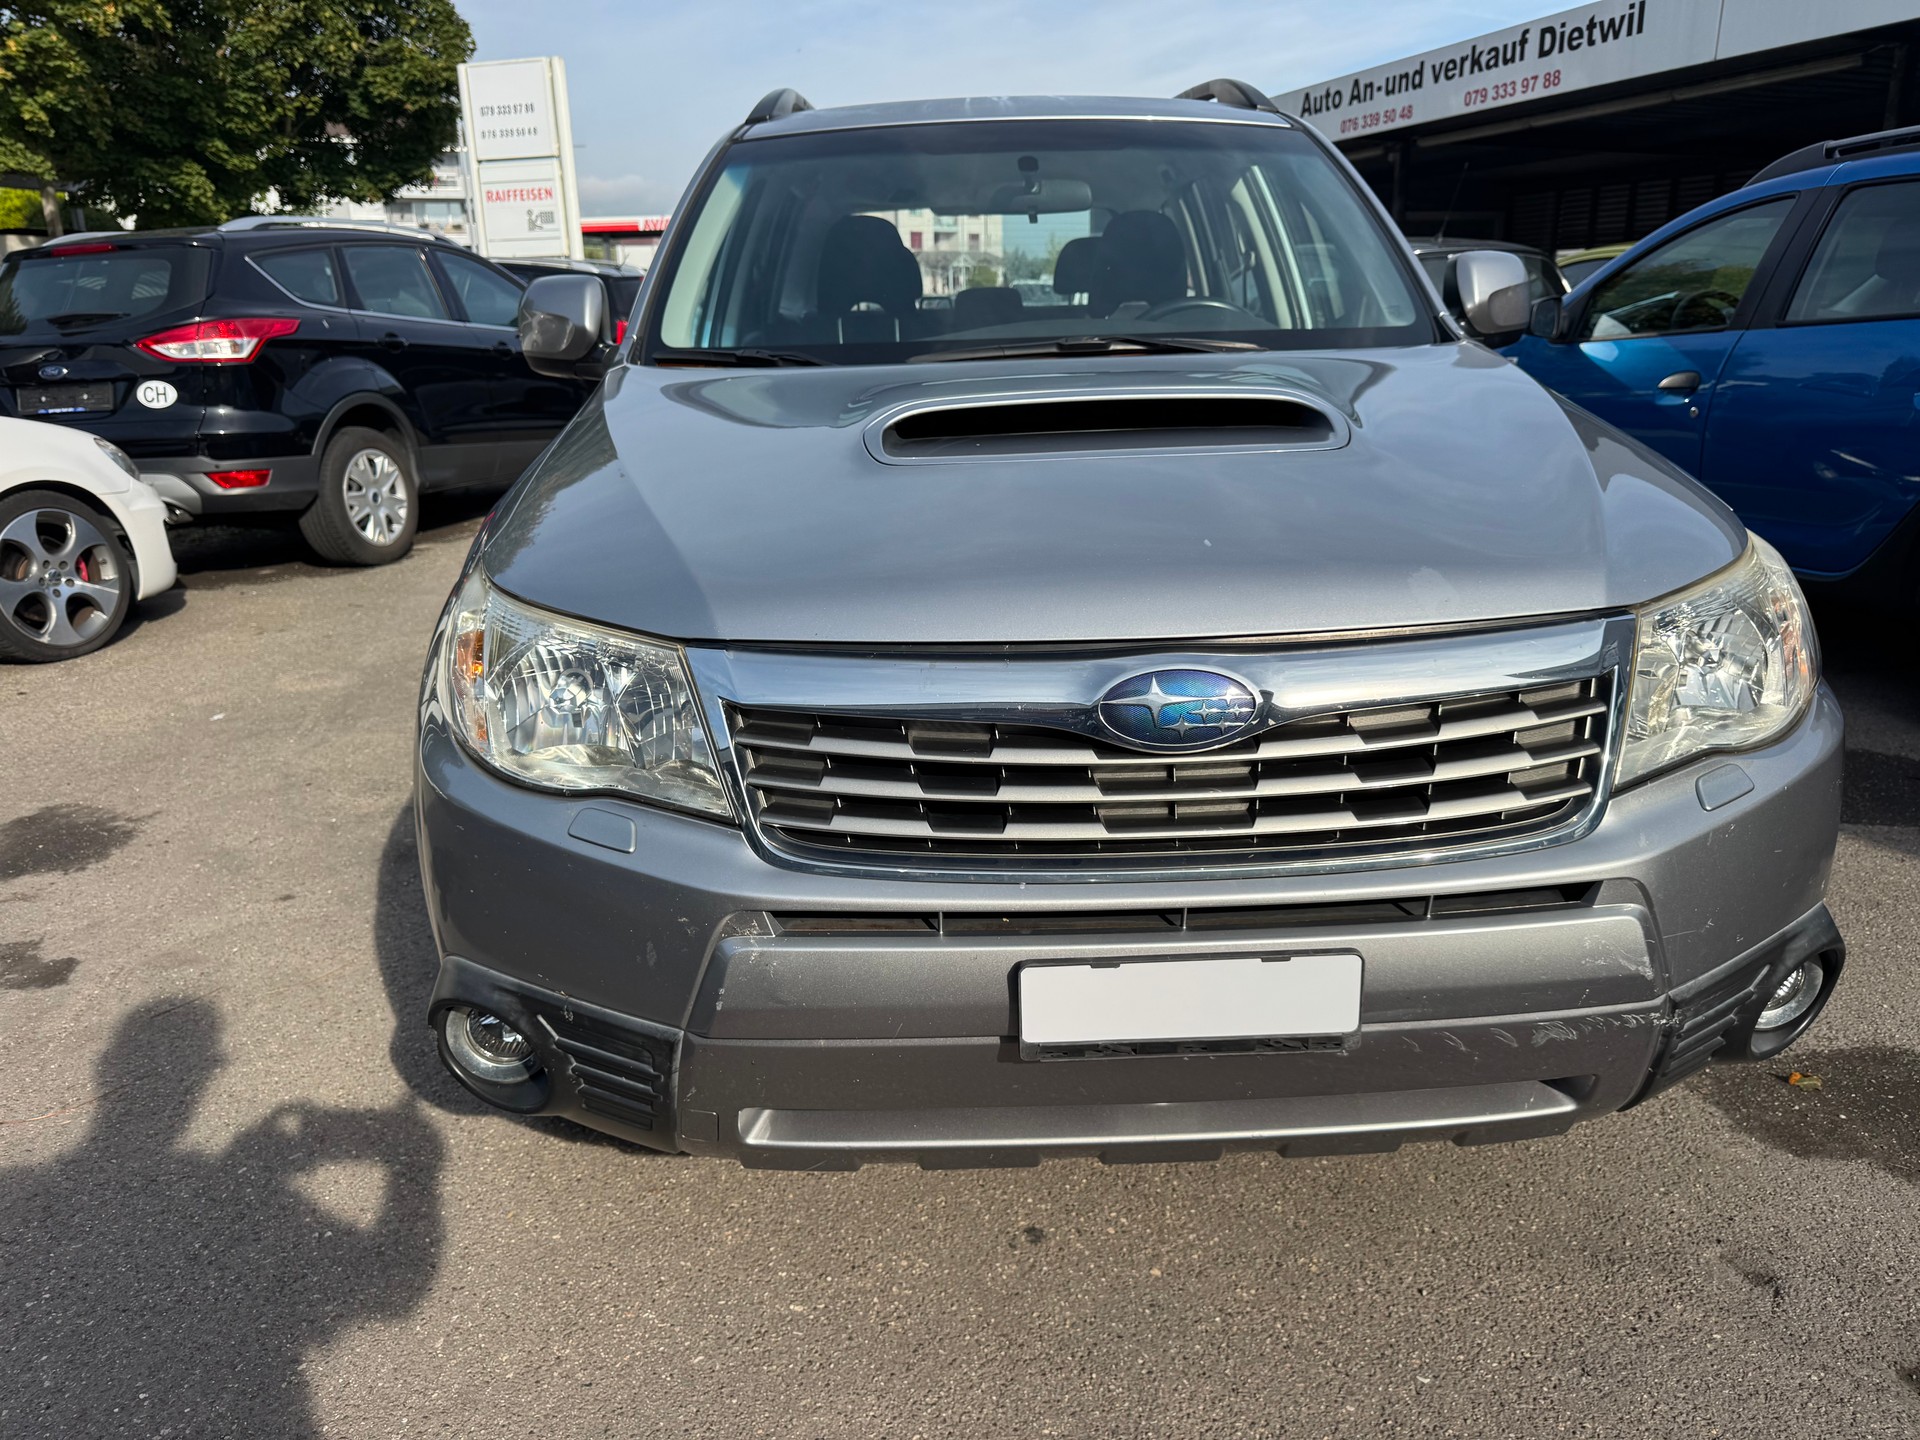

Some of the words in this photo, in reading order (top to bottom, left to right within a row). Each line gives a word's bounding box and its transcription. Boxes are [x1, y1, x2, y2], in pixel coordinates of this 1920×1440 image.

[1300, 87, 1343, 118] Auto
[1349, 60, 1425, 106] An-und
[1431, 28, 1530, 84] verkauf
[1537, 0, 1646, 59] Dietwil
[1463, 87, 1488, 107] 079
[1492, 81, 1517, 101] 333
[1521, 75, 1539, 94] 97
[1543, 69, 1562, 89] 88
[1340, 117, 1359, 133] 076
[1383, 108, 1397, 124] 50
[1399, 104, 1414, 120] 48
[486, 187, 553, 203] RAIFFEISEN
[143, 386, 168, 403] CH
